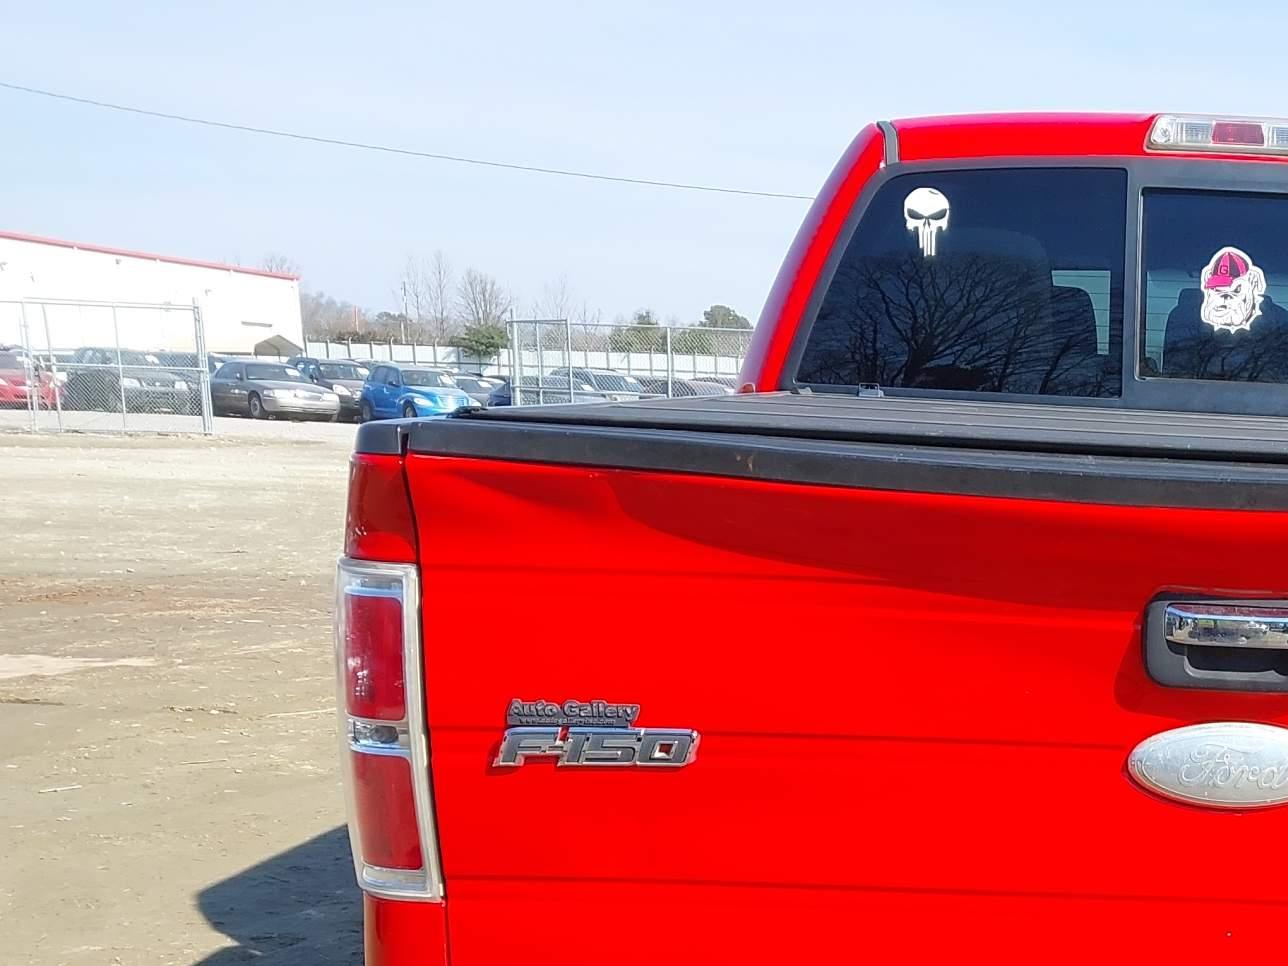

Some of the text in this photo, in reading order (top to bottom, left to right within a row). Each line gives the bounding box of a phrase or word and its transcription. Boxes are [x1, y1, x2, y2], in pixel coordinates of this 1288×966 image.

[1219, 264, 1229, 275] G
[509, 700, 638, 721] Auto Gallery
[493, 727, 700, 768] F-150
